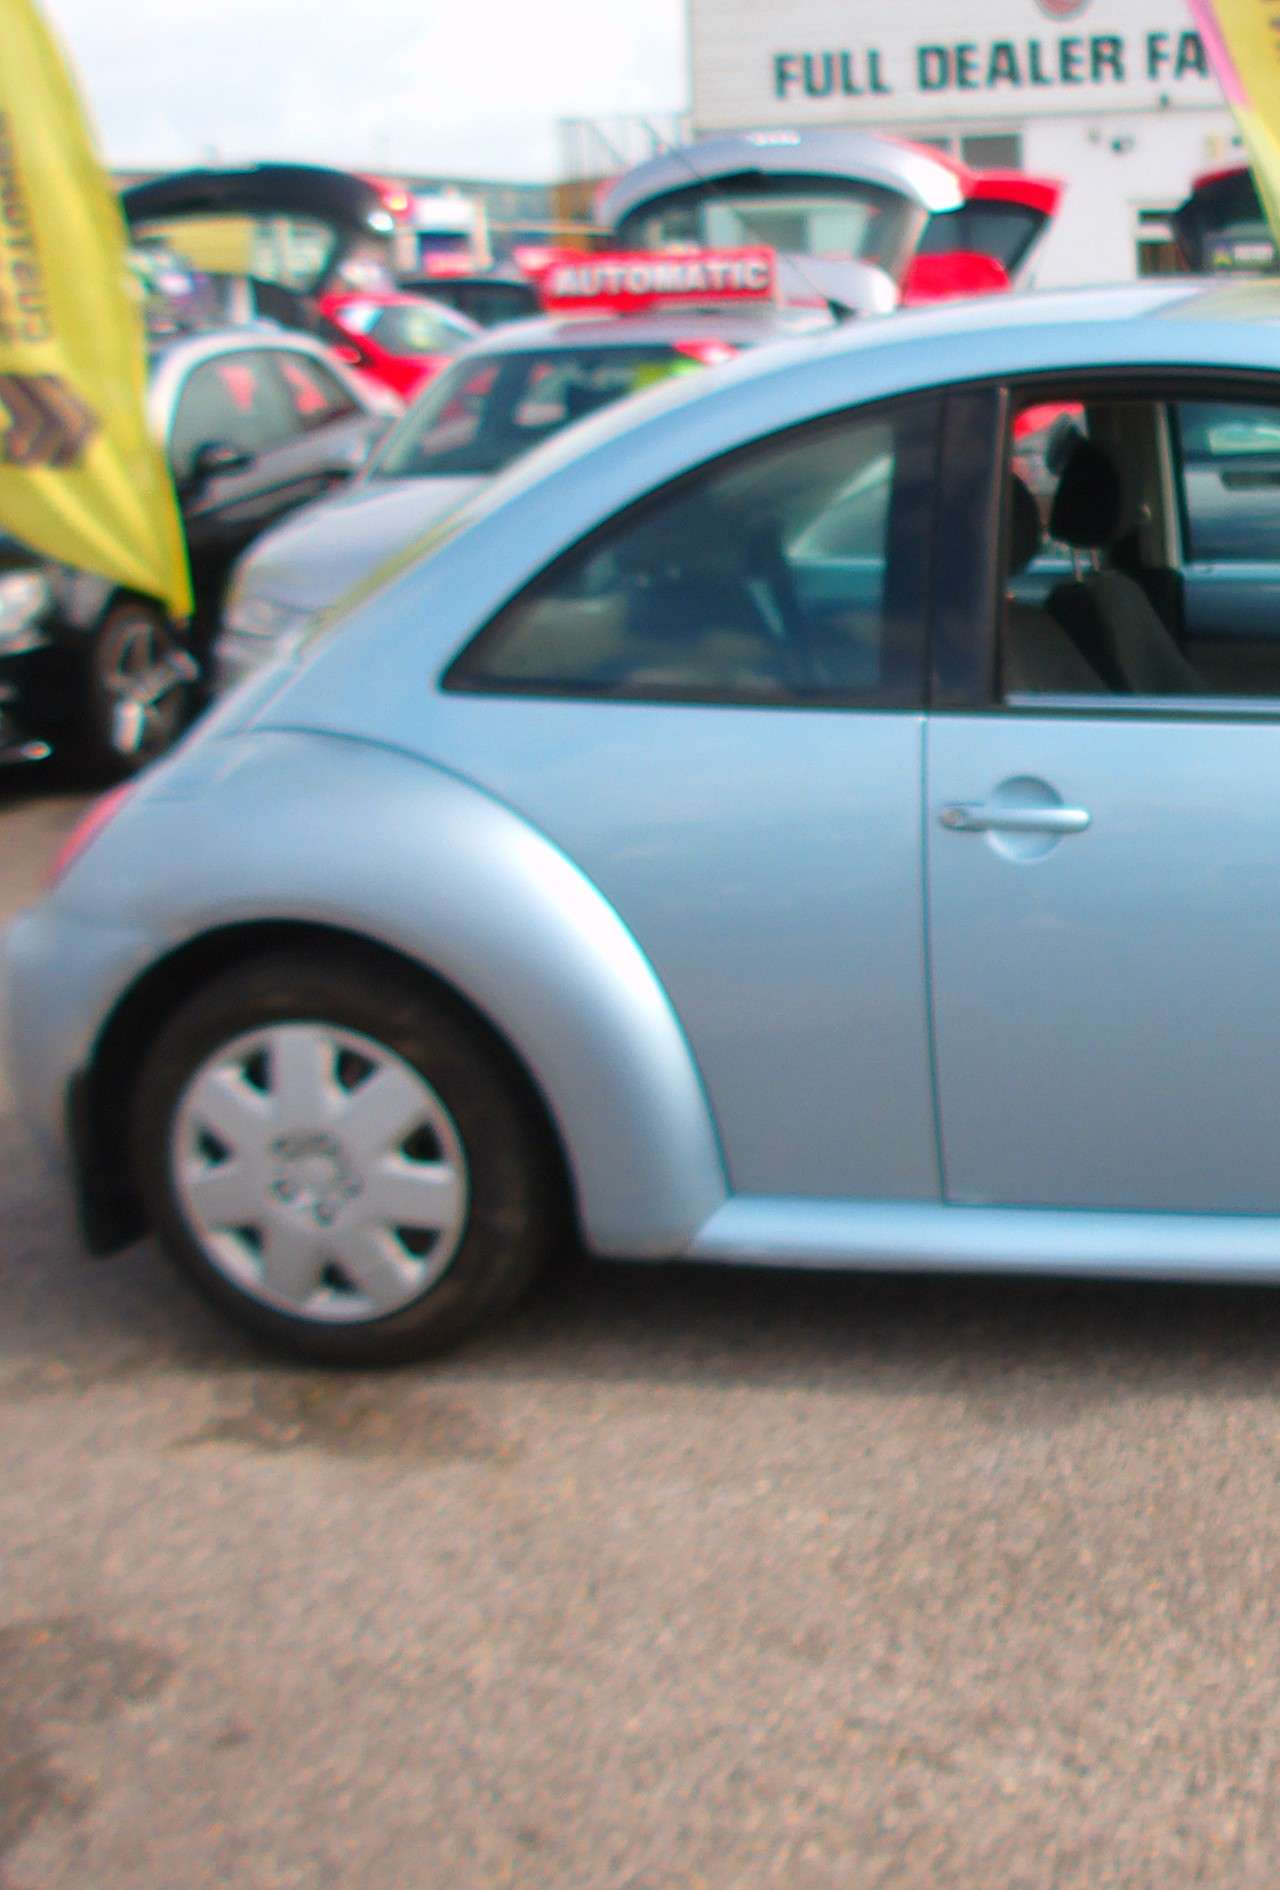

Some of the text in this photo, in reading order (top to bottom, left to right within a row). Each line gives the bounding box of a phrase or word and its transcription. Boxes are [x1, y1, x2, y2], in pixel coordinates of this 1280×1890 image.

[773, 48, 892, 98] FULL
[916, 33, 1126, 92] DEALER
[554, 257, 770, 298] AUTOMATIC
